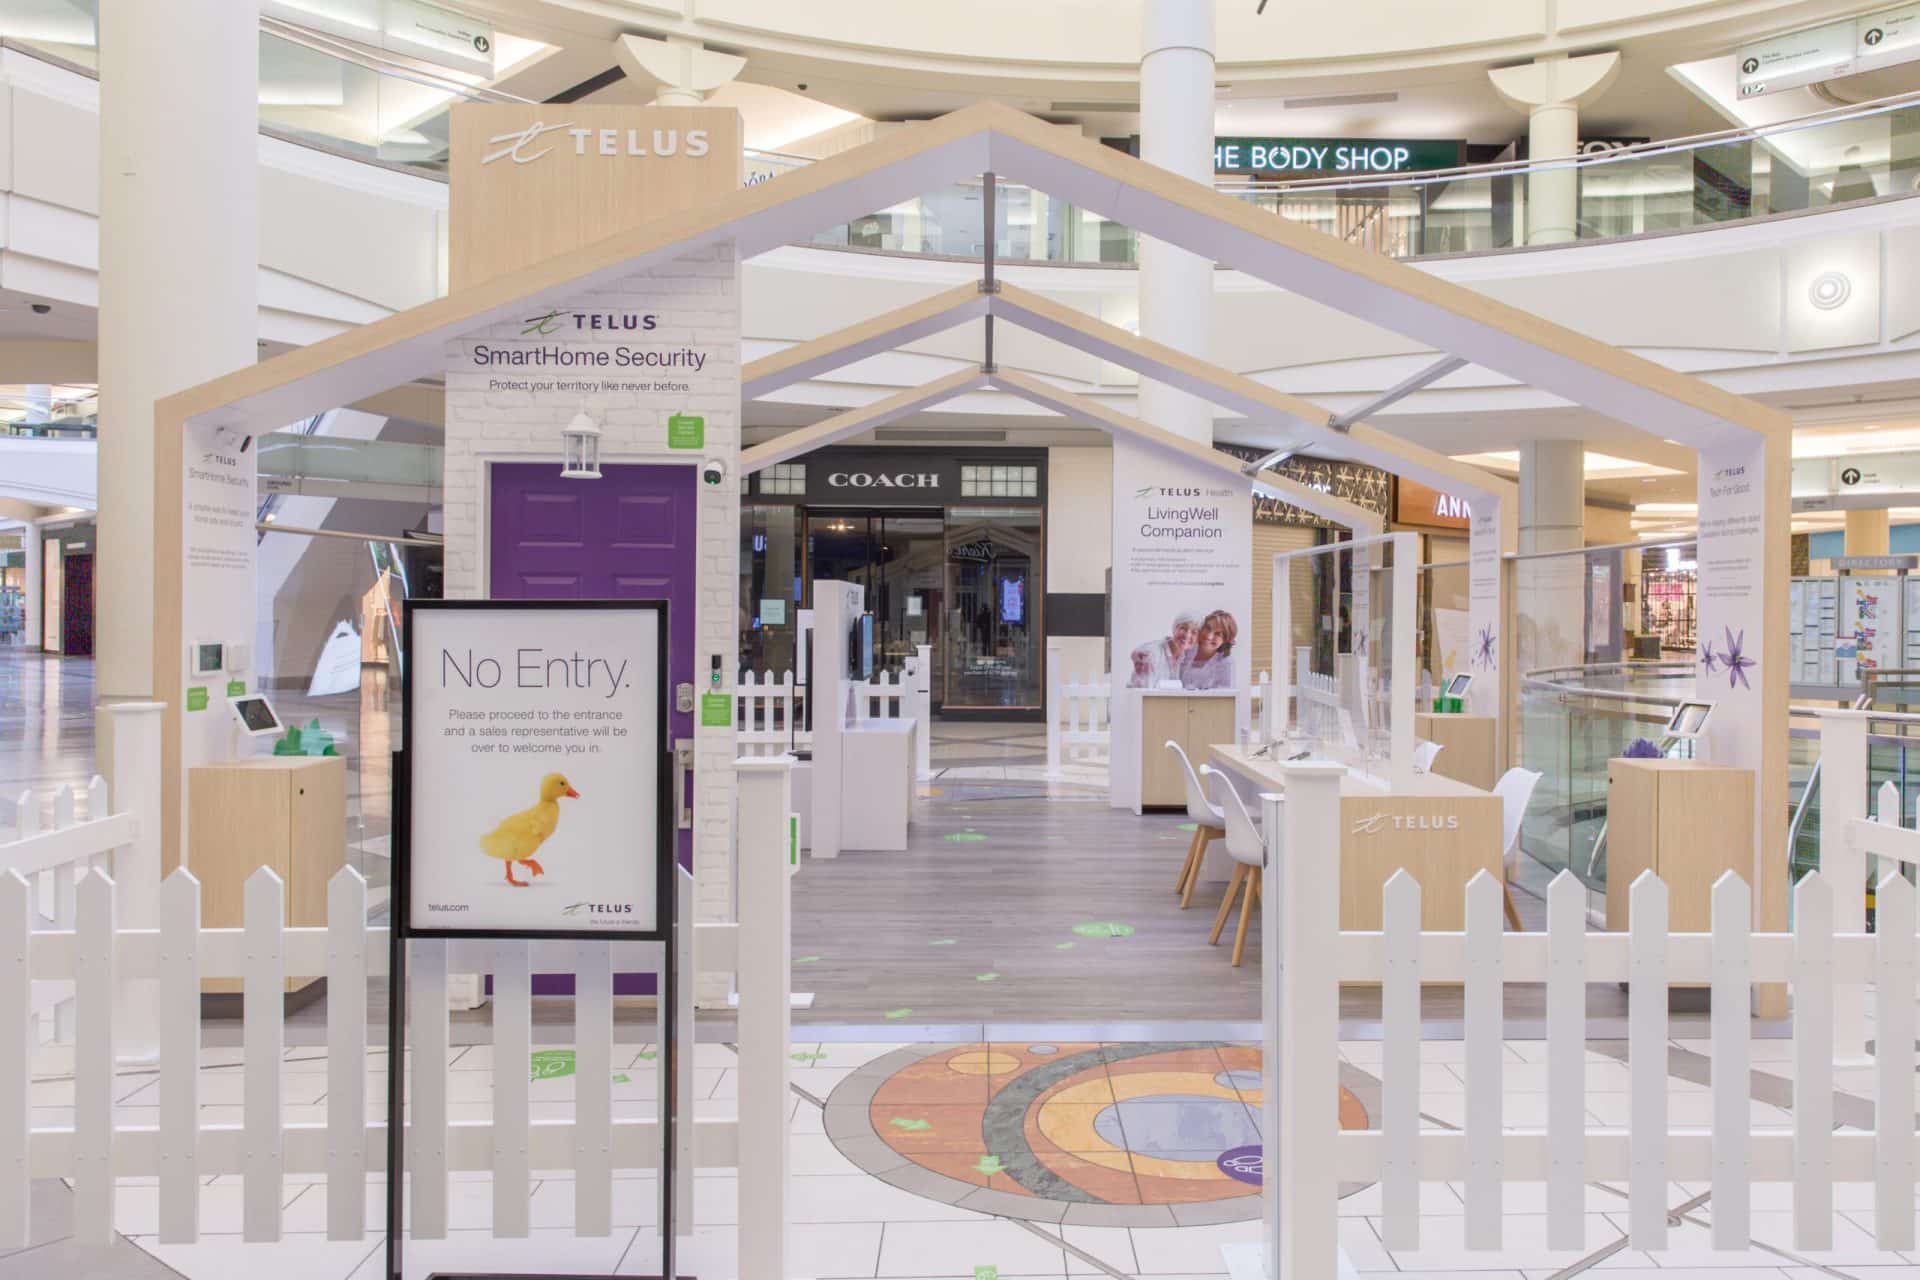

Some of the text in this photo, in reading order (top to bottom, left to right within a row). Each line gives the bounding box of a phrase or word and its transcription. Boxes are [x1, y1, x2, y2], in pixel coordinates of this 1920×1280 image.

[569, 128, 709, 157] TELUS
[1214, 145, 1409, 170] HE BODY SHOP
[573, 314, 657, 331] TELUS
[473, 345, 706, 371] SmartHome Security
[489, 379, 528, 391] Protect
[531, 383, 553, 394] your
[556, 381, 599, 394] territory
[601, 381, 619, 391] like
[621, 383, 651, 392] never
[216, 455, 236, 467] TELUS
[828, 472, 940, 488] COACH
[1160, 487, 1201, 497] TELUS
[1148, 506, 1219, 524] LivingWell
[1140, 524, 1223, 541] Companion
[443, 648, 630, 699] No Entry.
[449, 709, 623, 723] Please proceed to the entrance
[444, 726, 628, 739] and a sales representative will be
[471, 743, 495, 753] over
[499, 743, 509, 753] to
[513, 742, 562, 753] welcome
[565, 744, 585, 756] you
[1393, 815, 1459, 829] TELUS
[589, 903, 632, 913] TELUS
